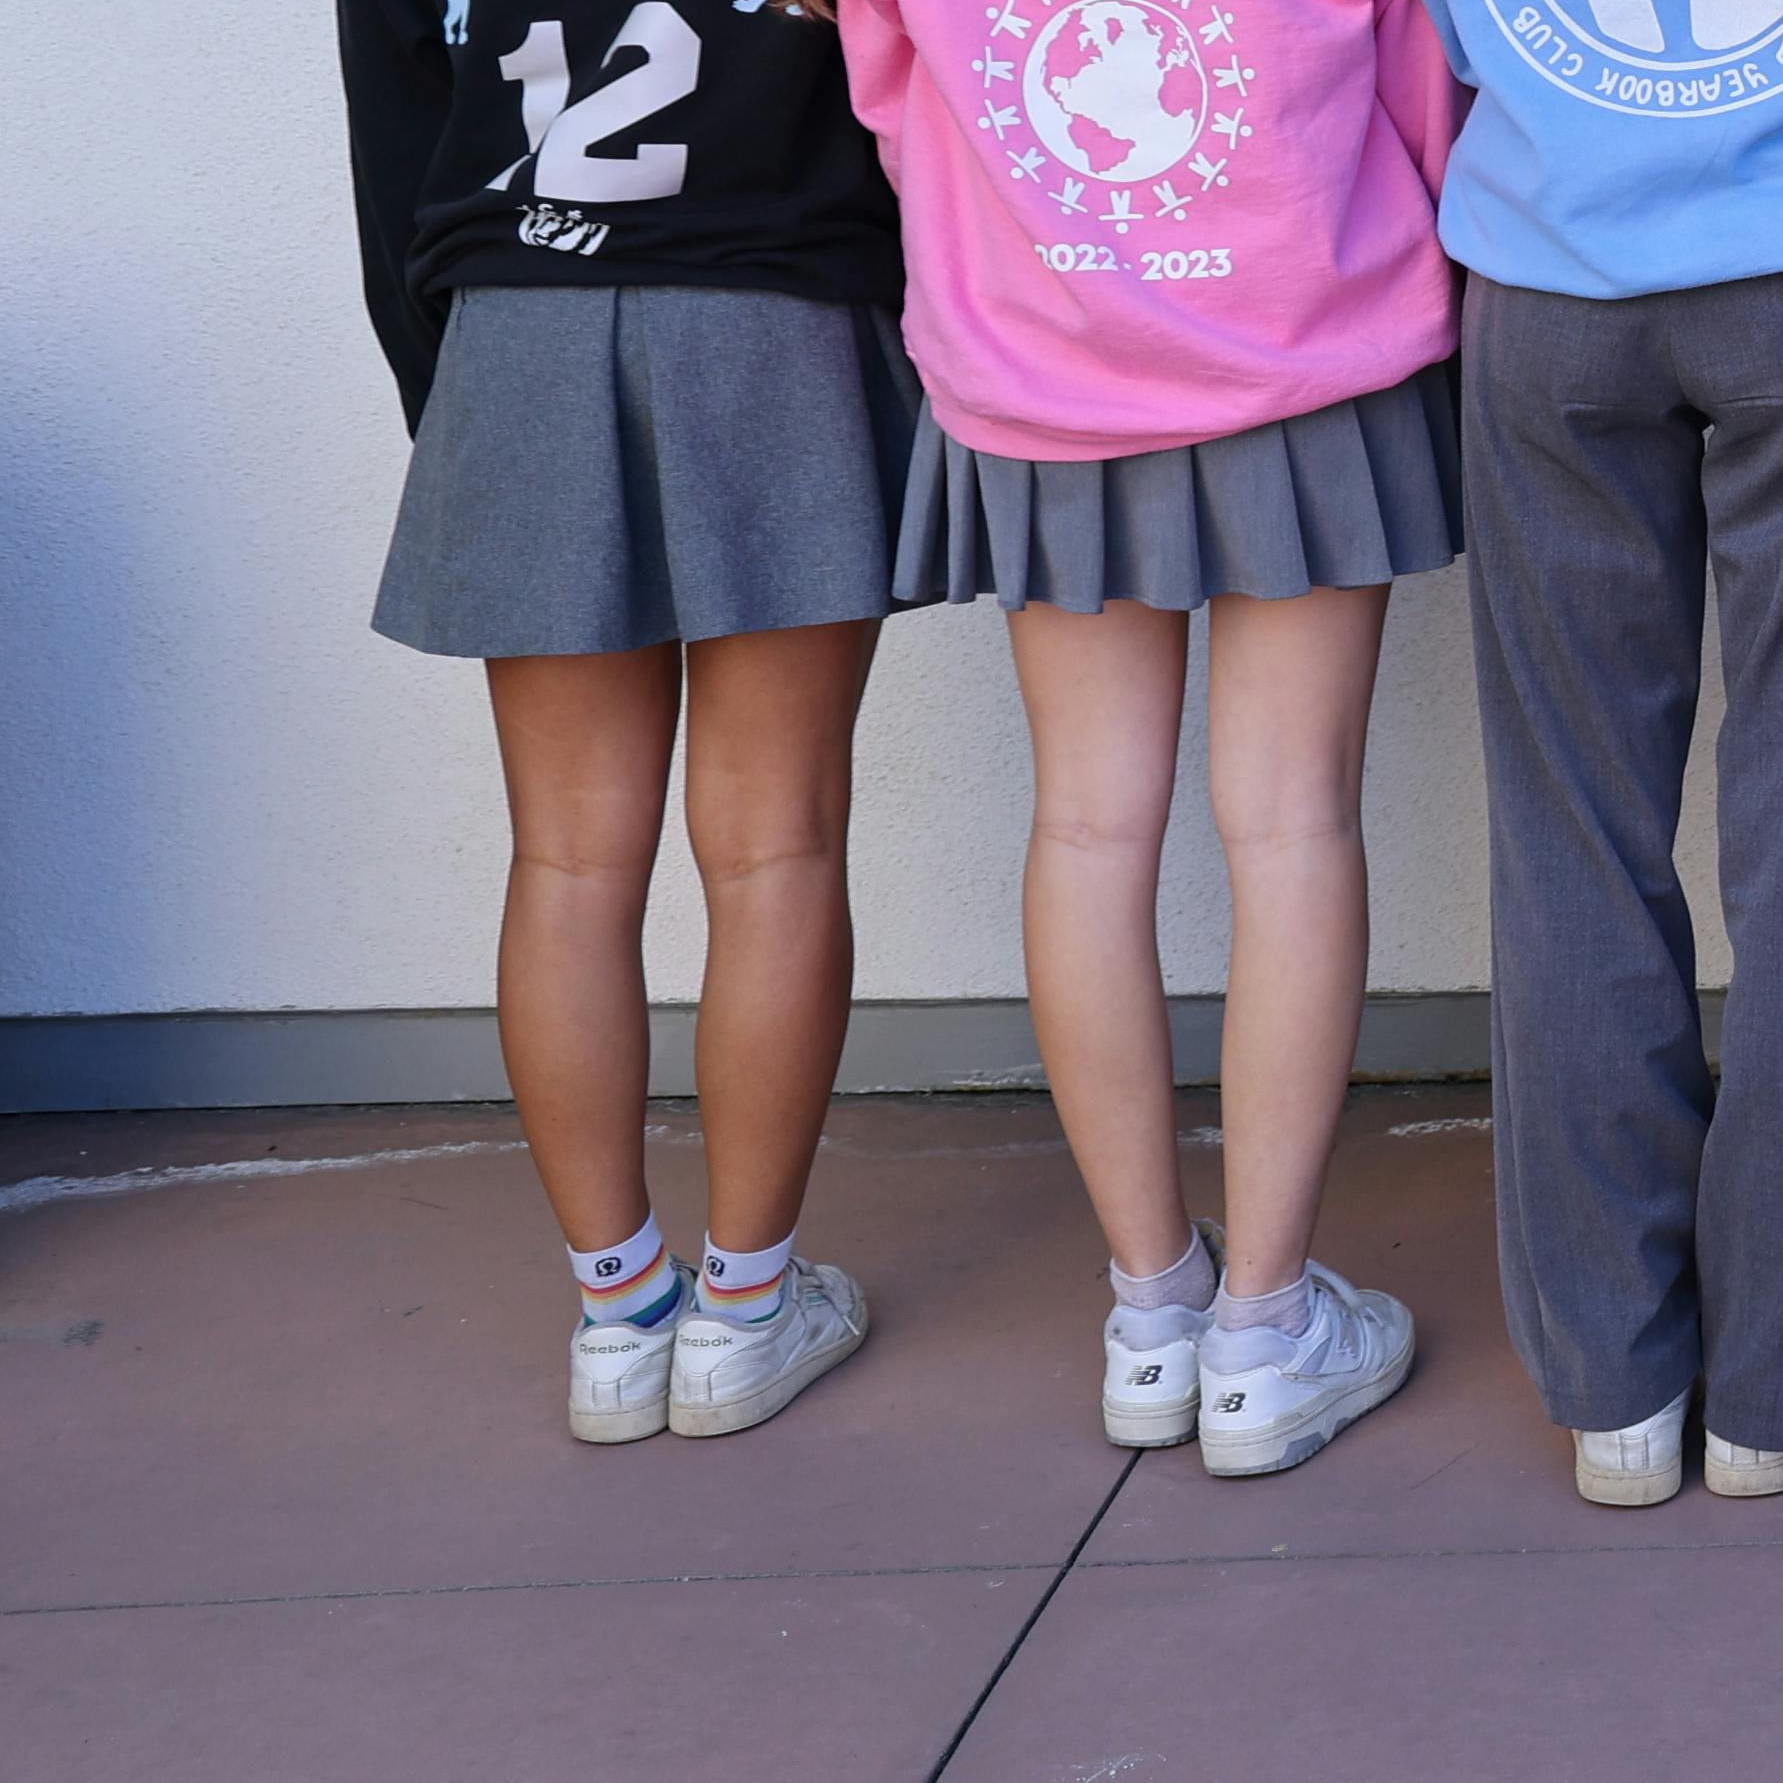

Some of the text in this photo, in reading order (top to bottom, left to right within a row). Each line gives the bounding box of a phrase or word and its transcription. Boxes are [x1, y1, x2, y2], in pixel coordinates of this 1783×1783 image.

[1512, 5, 1585, 78] CLUB
[485, 1, 702, 203] 12
[1595, 62, 1770, 108] YEARBOOK
[1140, 248, 1233, 280] 2023
[579, 1341, 641, 1355] Reebok
